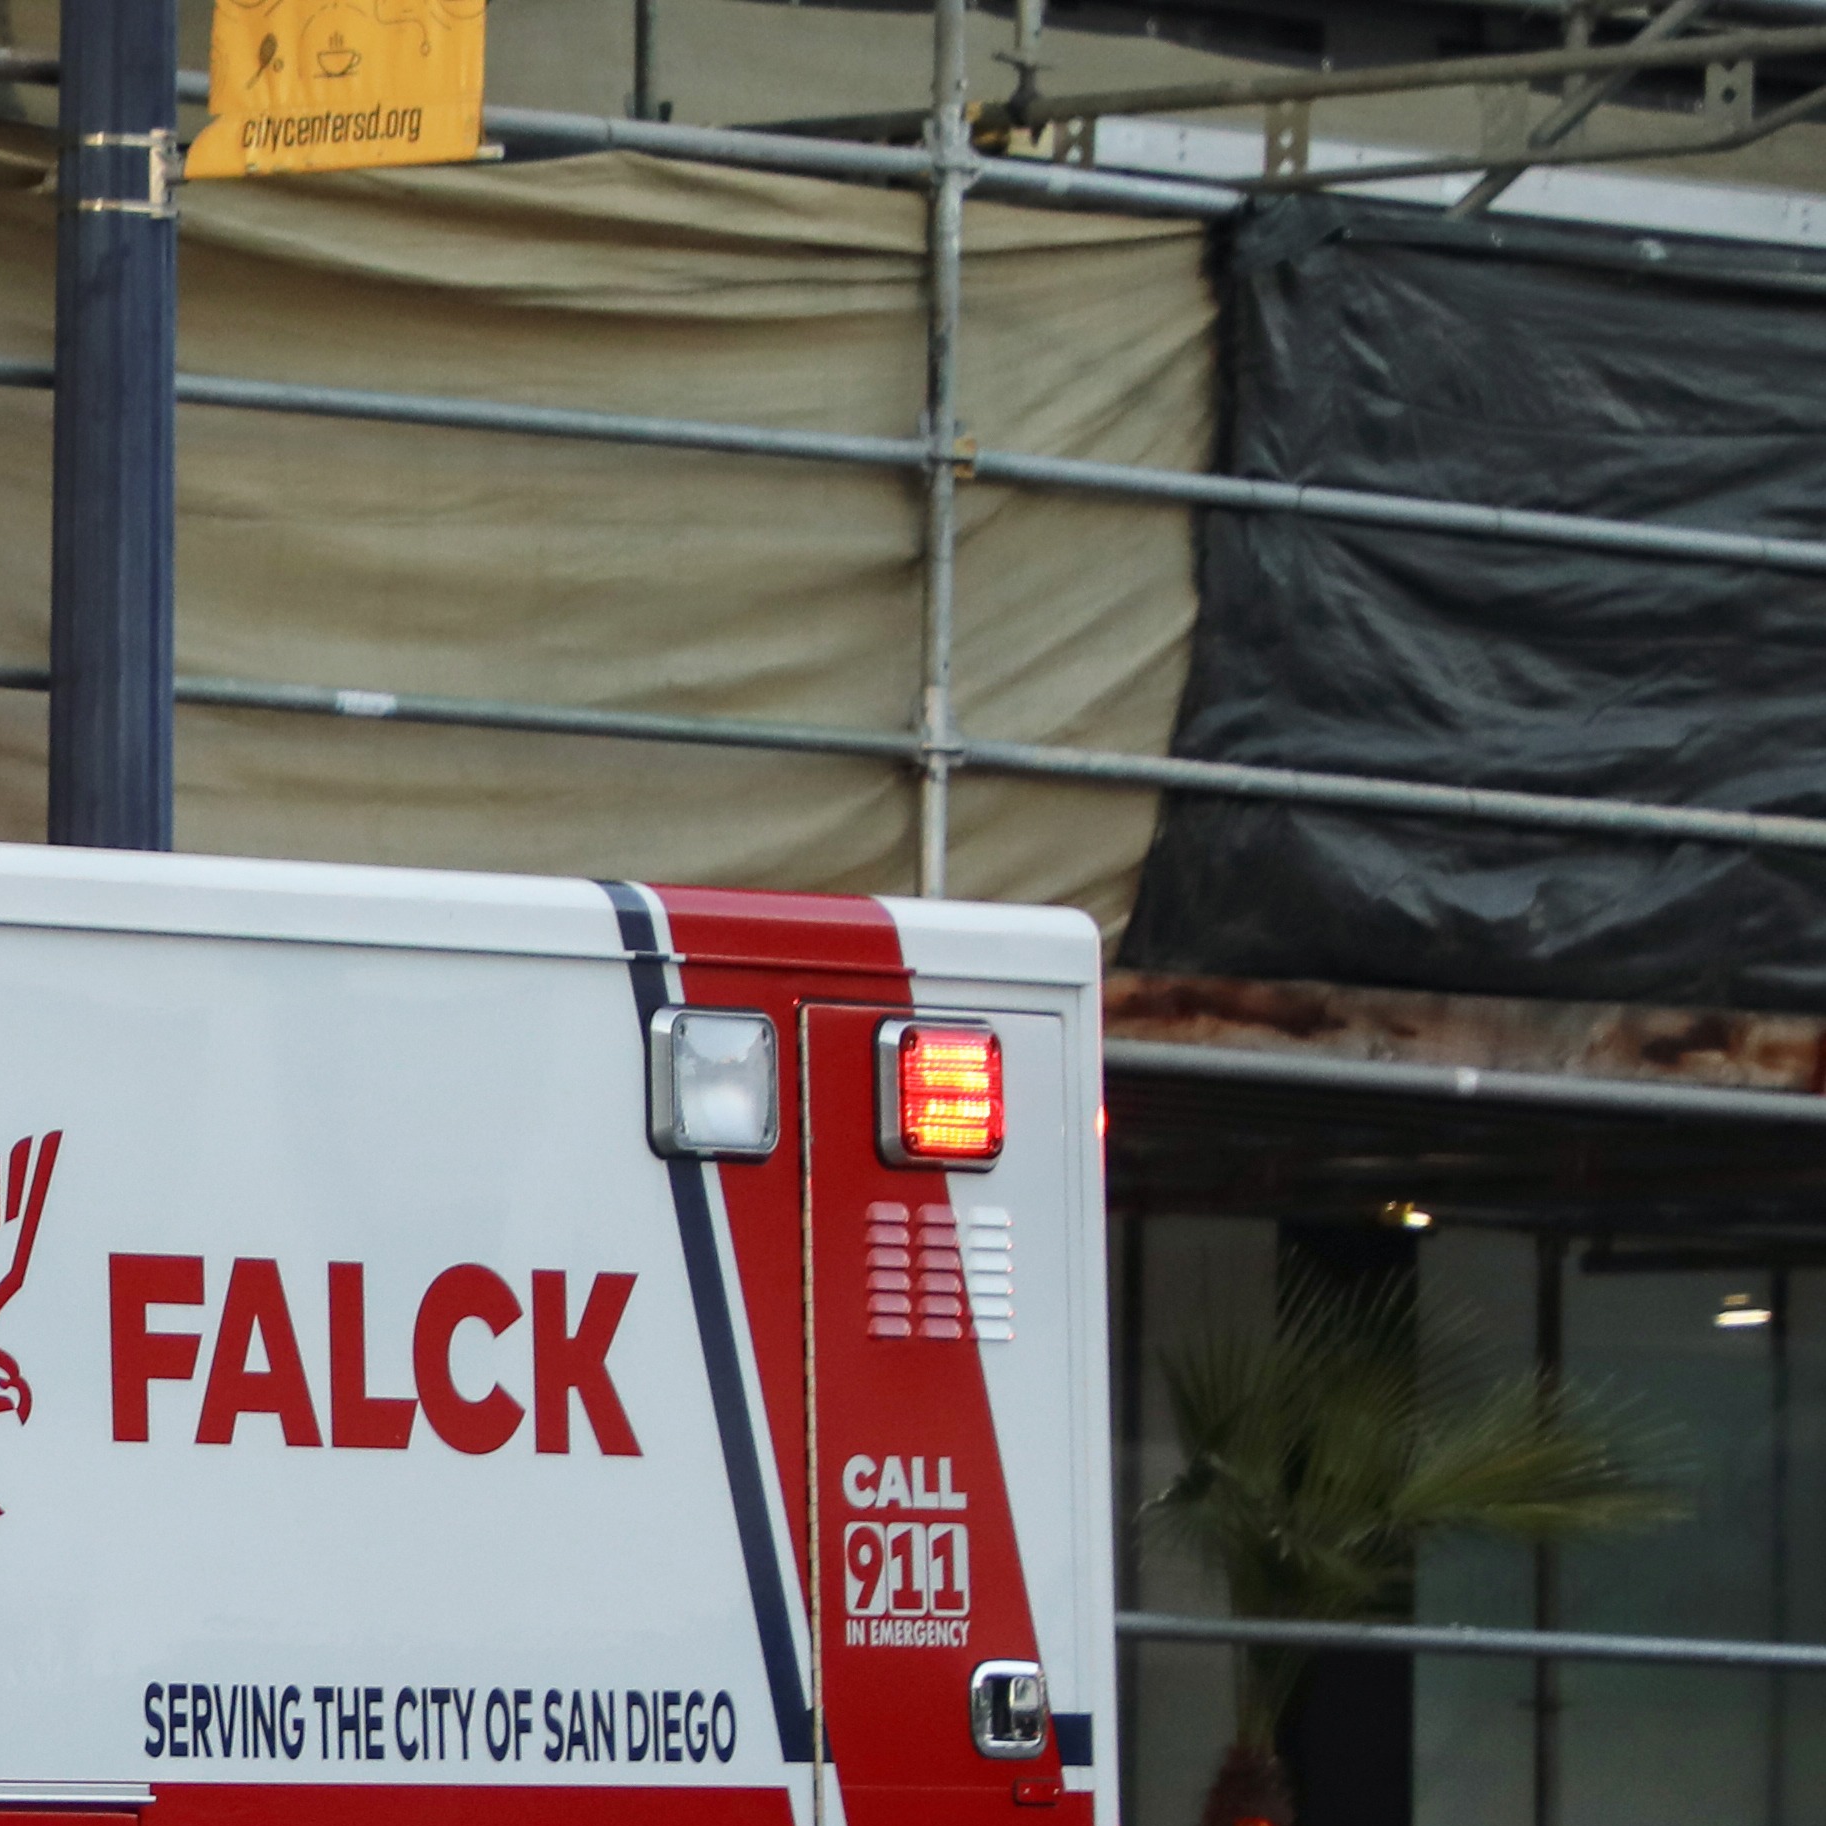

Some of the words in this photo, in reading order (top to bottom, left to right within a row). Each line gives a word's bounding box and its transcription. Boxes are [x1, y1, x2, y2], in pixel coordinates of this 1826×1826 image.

[241, 100, 422, 152] citycentersd.org
[108, 1252, 643, 1457] FALCK
[842, 1454, 968, 1511] CALL
[846, 1523, 966, 1612] 911
[846, 1619, 866, 1647] IN
[870, 1618, 970, 1648] EMERGENCY
[144, 1682, 305, 1760] SERVING
[313, 1686, 385, 1760] THE
[395, 1687, 476, 1762] CITY
[485, 1688, 534, 1762] OF
[543, 1689, 616, 1763] SAN
[626, 1689, 737, 1764] DIEGO
